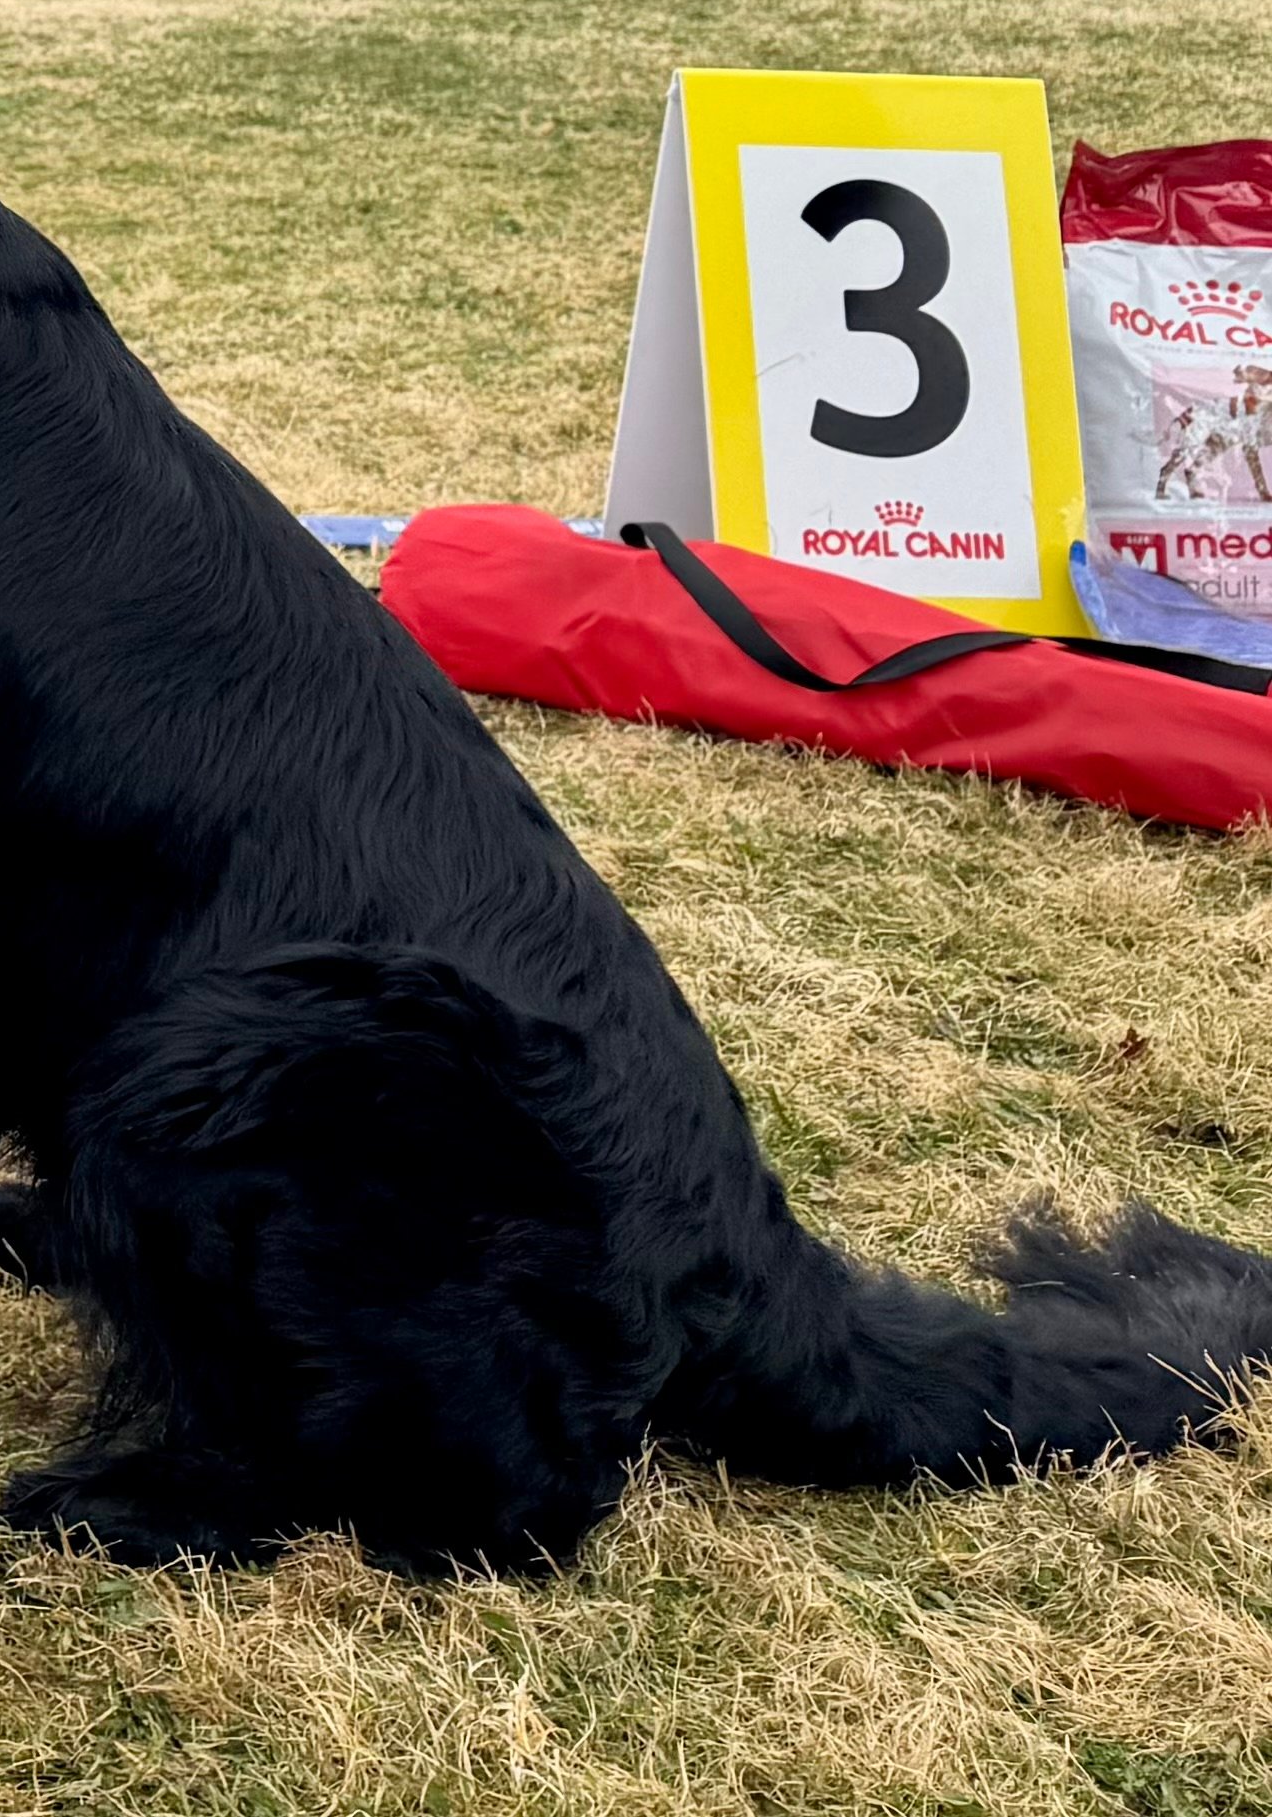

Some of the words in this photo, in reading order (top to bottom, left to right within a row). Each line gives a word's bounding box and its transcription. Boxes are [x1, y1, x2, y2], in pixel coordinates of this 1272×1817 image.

[801, 179, 970, 458] 3
[1110, 301, 1218, 345] ROYAL
[803, 529, 899, 557] ROYAL
[905, 531, 1005, 560] CANIN
